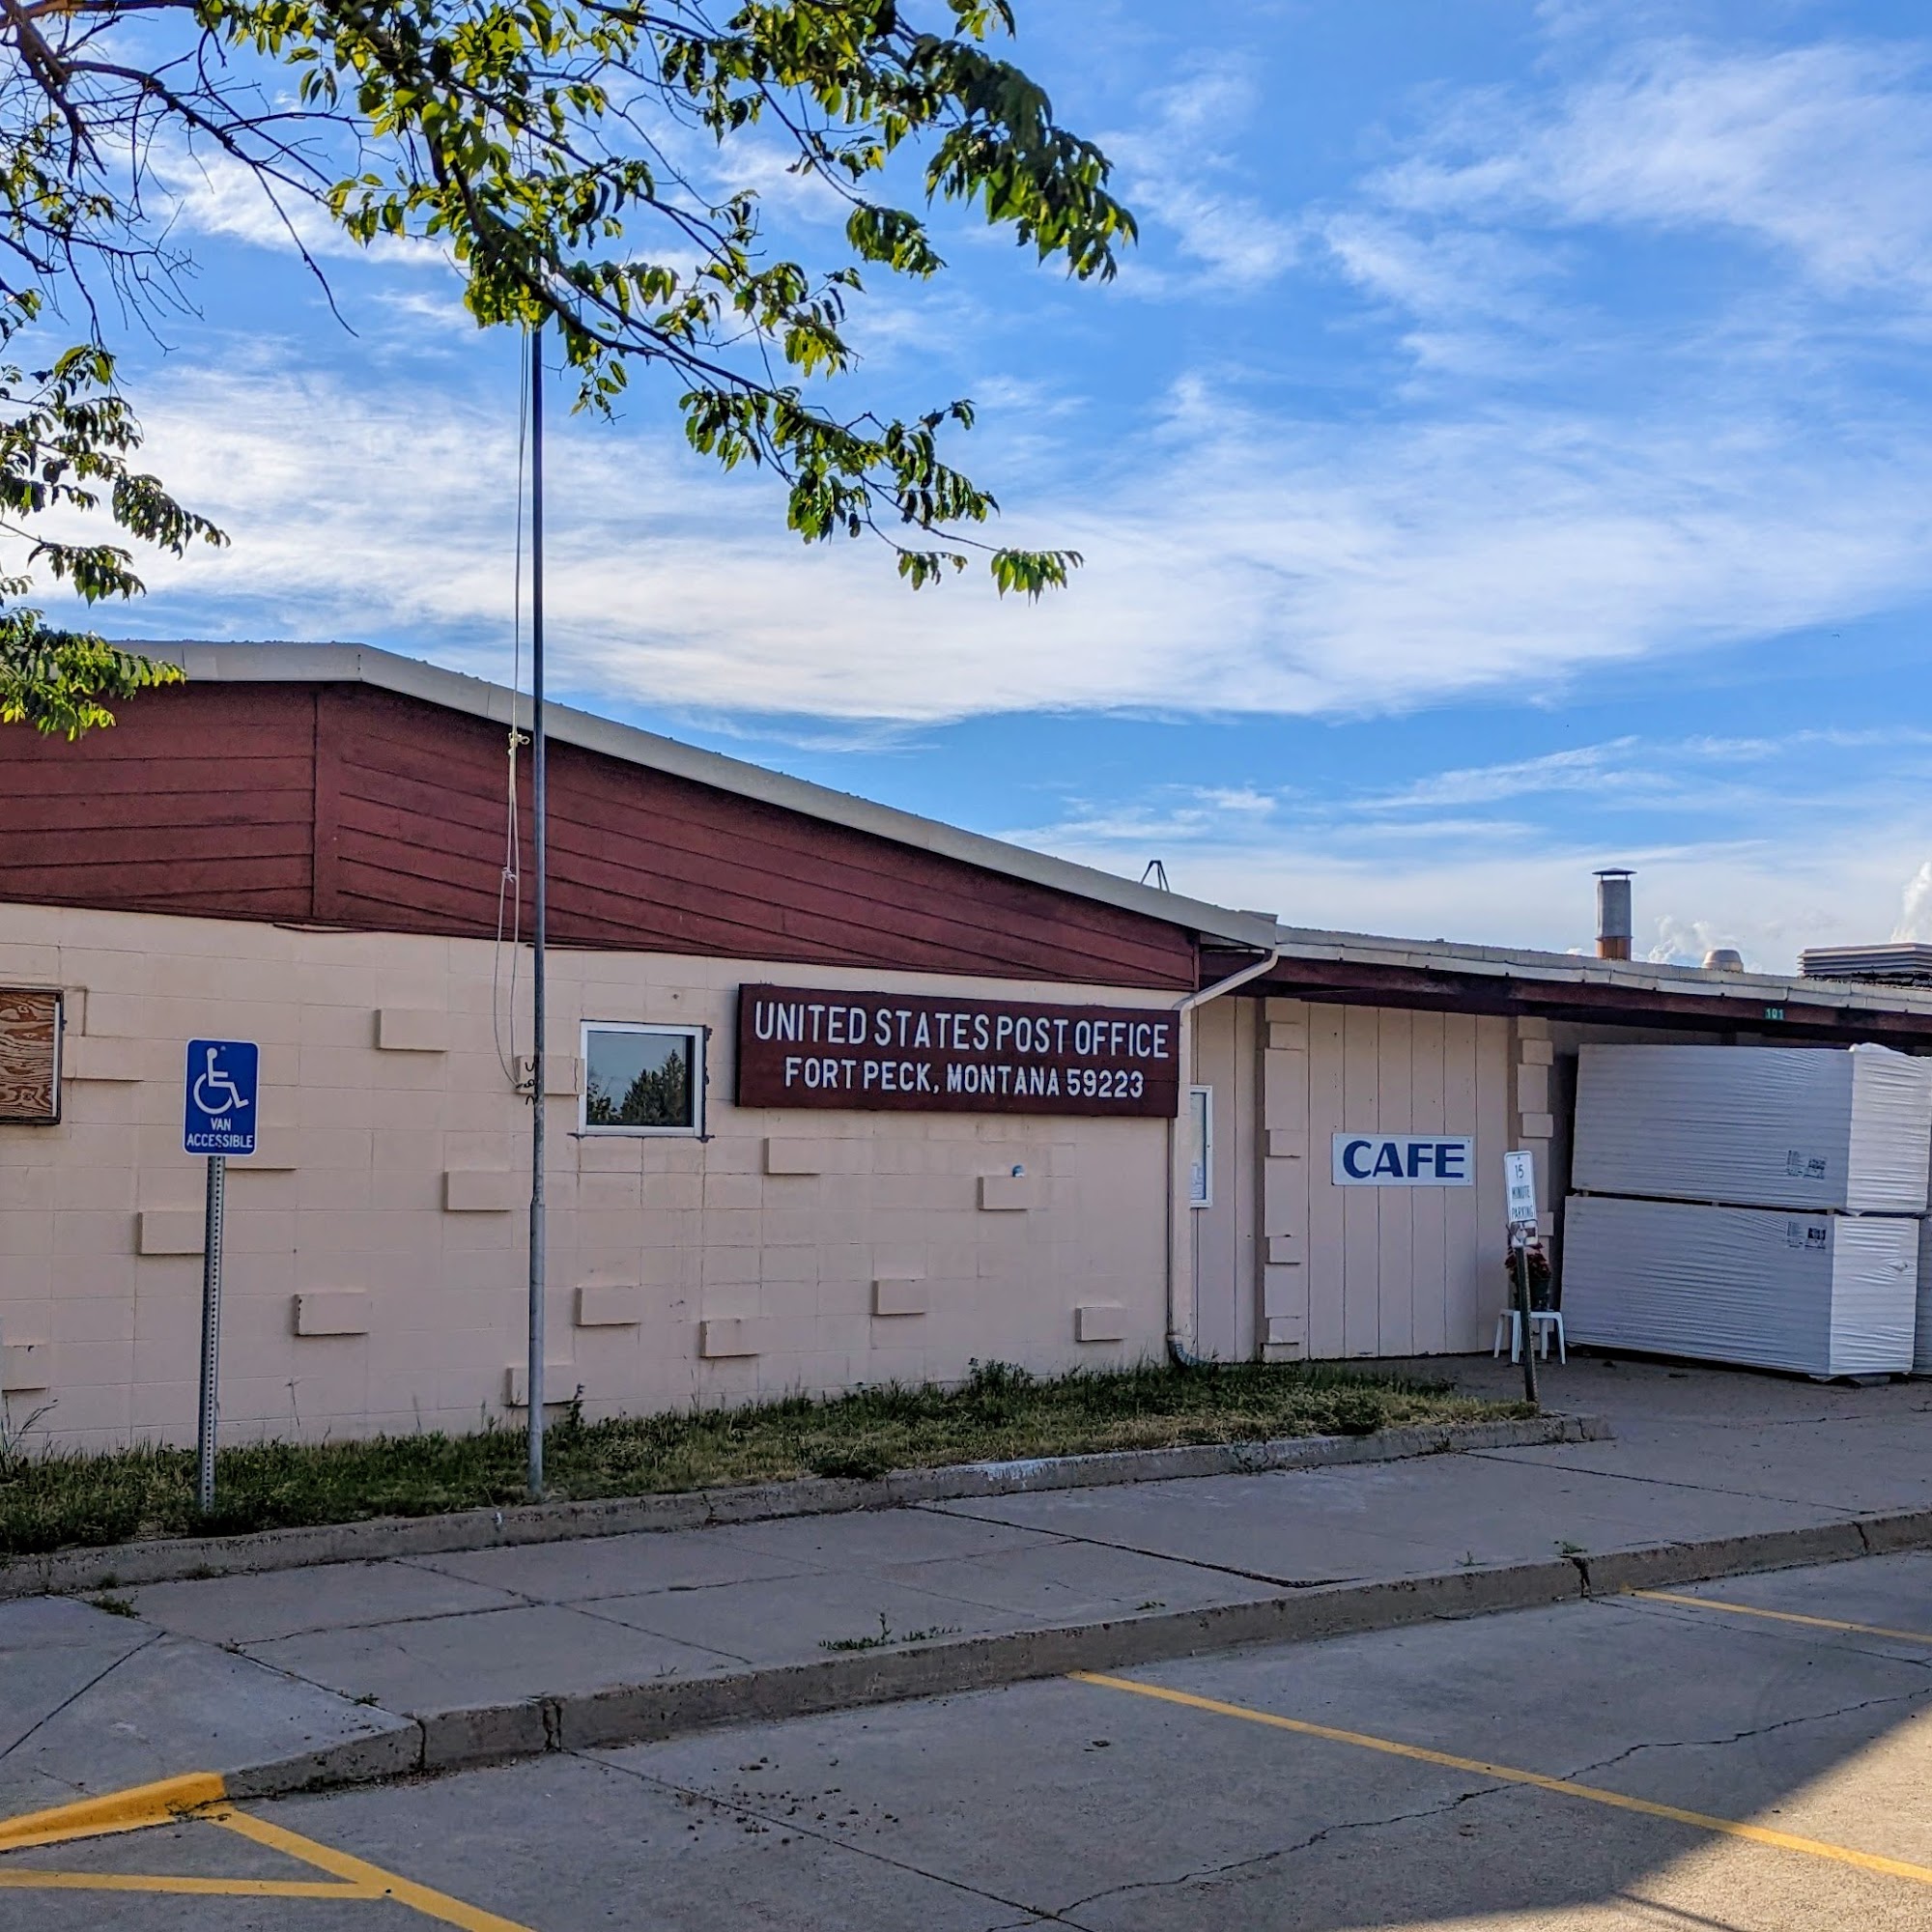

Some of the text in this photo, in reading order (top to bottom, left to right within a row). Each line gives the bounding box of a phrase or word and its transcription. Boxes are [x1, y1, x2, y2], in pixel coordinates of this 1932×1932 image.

[1766, 1008, 1784, 1020] 101
[754, 1001, 1170, 1059] UNITED STATES POST OFFICE
[784, 1057, 1145, 1098] FORT PECK, MONTANA 59223
[211, 1118, 232, 1131] VAN
[186, 1133, 253, 1149] ACCESSIBLE
[1343, 1140, 1465, 1179] CAFE
[1515, 1164, 1524, 1179] 15
[1511, 1185, 1530, 1199] MINUTE
[1512, 1206, 1534, 1219] PARKING
